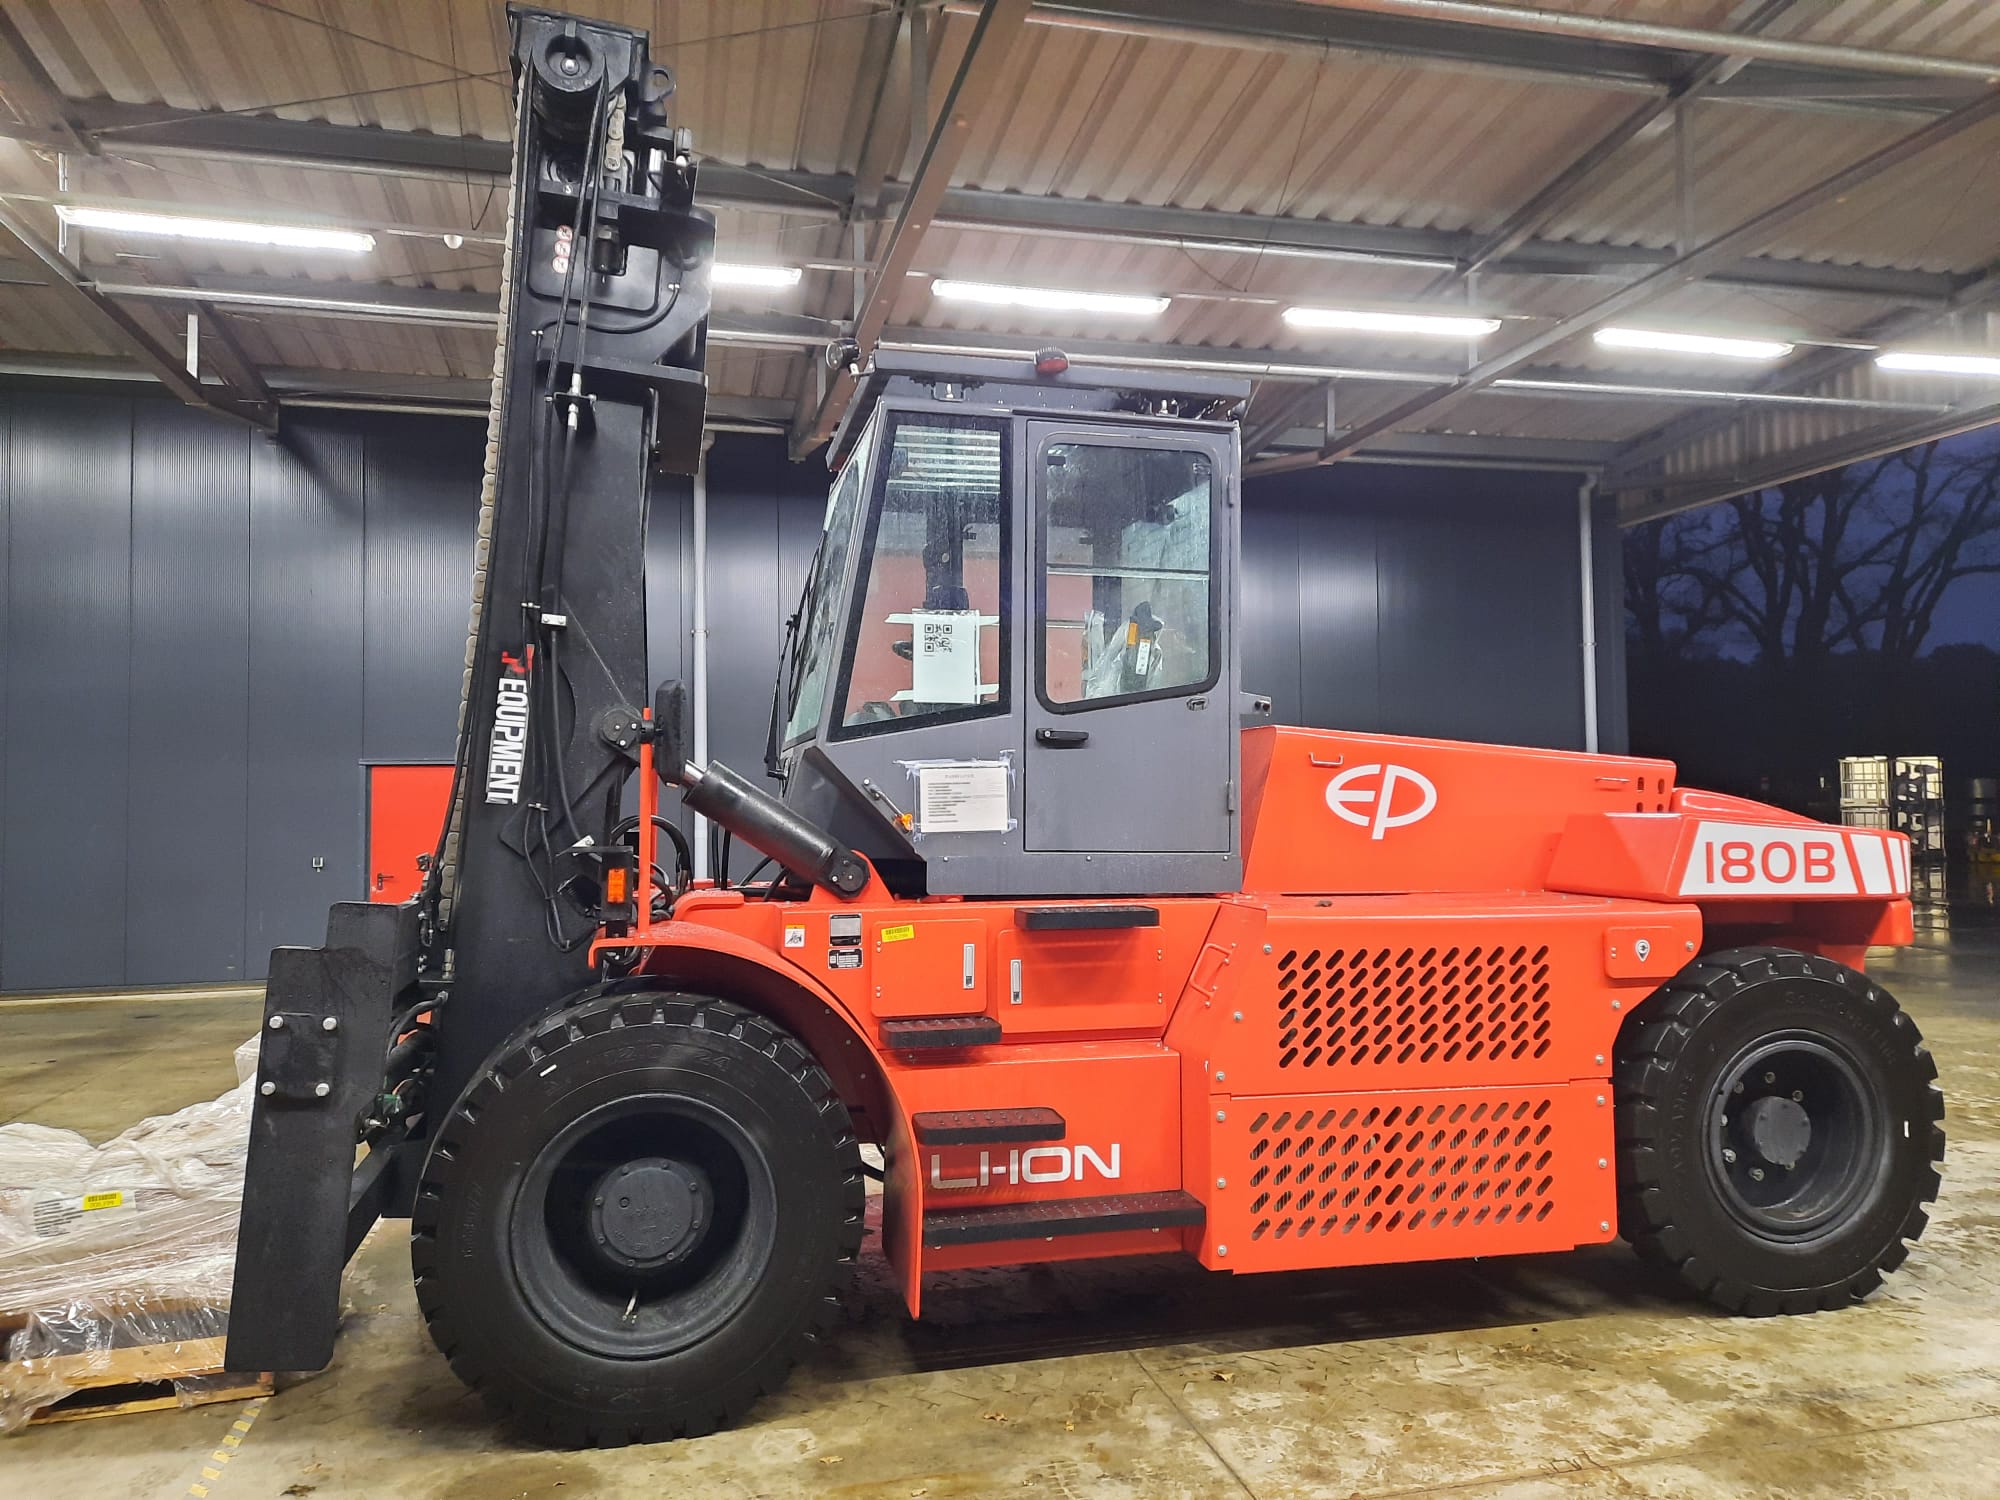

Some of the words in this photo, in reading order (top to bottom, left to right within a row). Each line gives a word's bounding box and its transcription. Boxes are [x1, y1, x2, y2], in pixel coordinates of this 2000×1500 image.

[486, 677, 530, 804] EQUIPMENT
[1325, 763, 1438, 840] EP
[1704, 840, 1836, 884] 180B
[930, 1143, 1121, 1188] LI-ION
